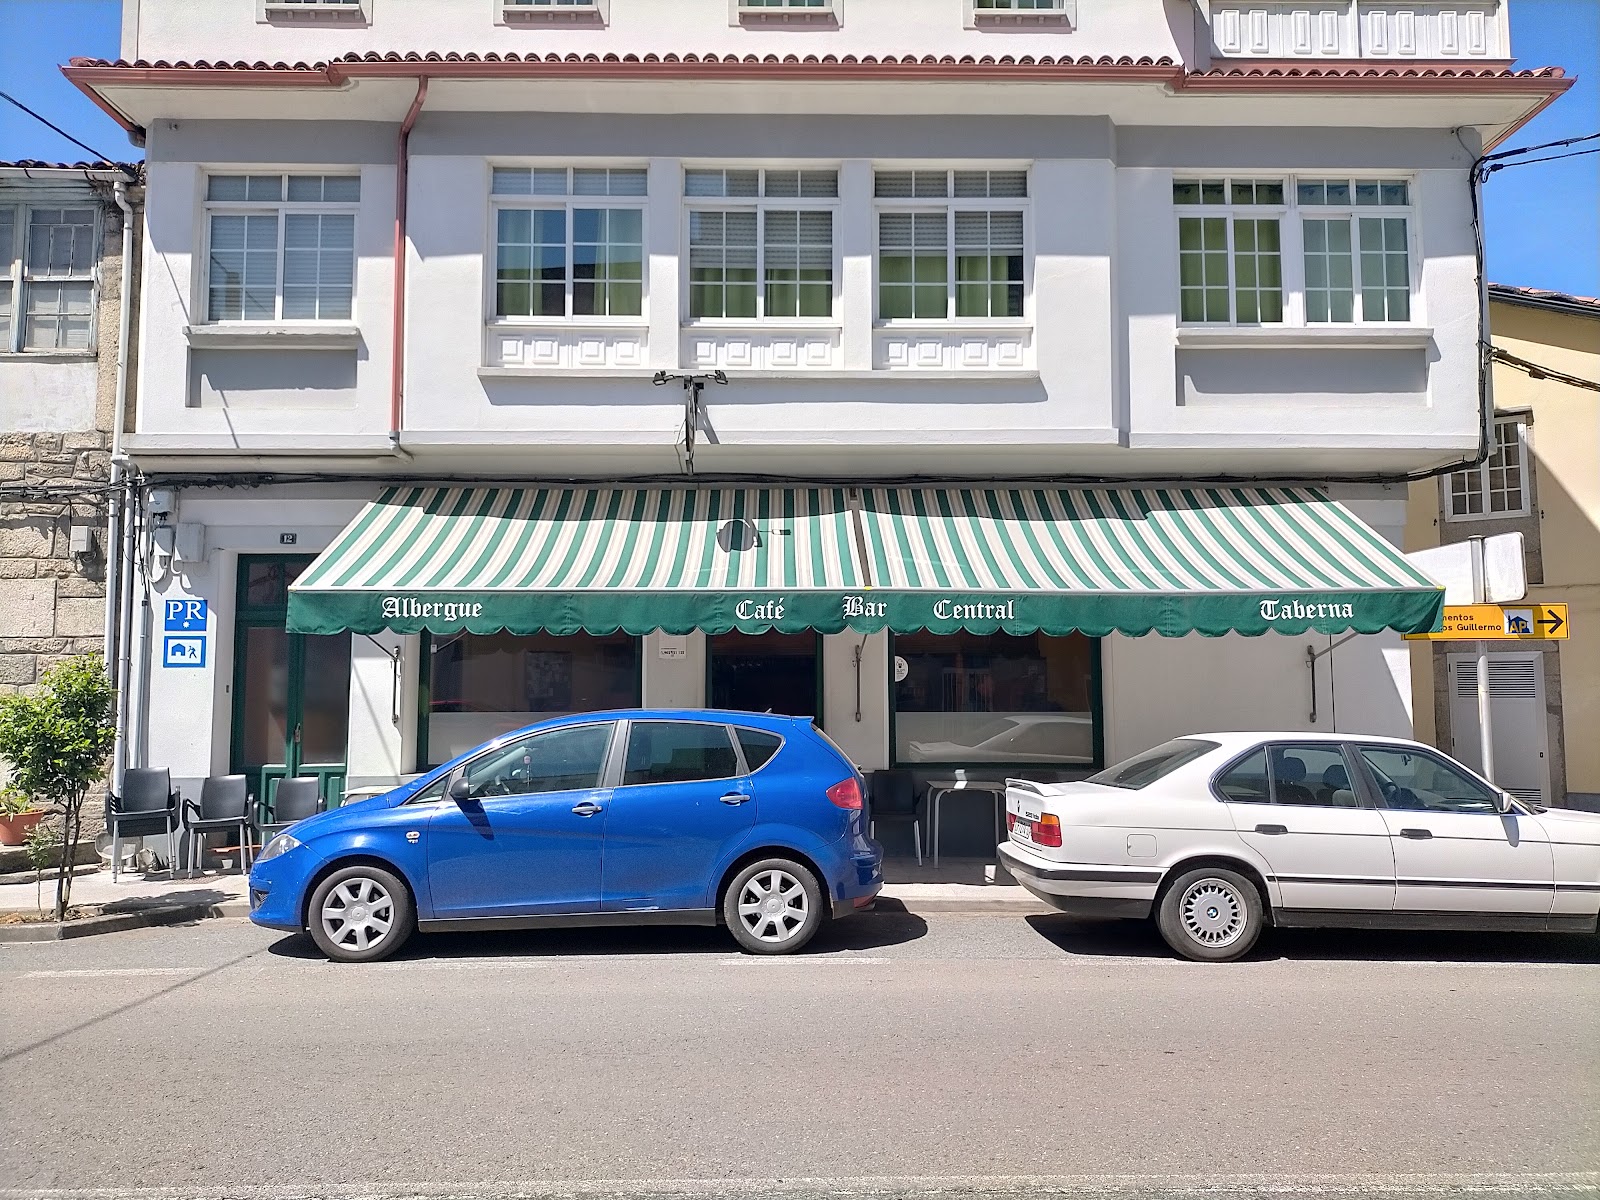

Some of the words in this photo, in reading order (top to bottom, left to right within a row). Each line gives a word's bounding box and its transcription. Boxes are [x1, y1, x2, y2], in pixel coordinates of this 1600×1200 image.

[284, 534, 293, 543] 12
[166, 601, 205, 620] PR
[382, 597, 483, 621] Albergue
[735, 598, 785, 620] Café
[842, 596, 887, 620] Bar
[933, 599, 1015, 620] Central
[1260, 599, 1354, 621] Taberna
[1456, 623, 1502, 631] Guillermo
